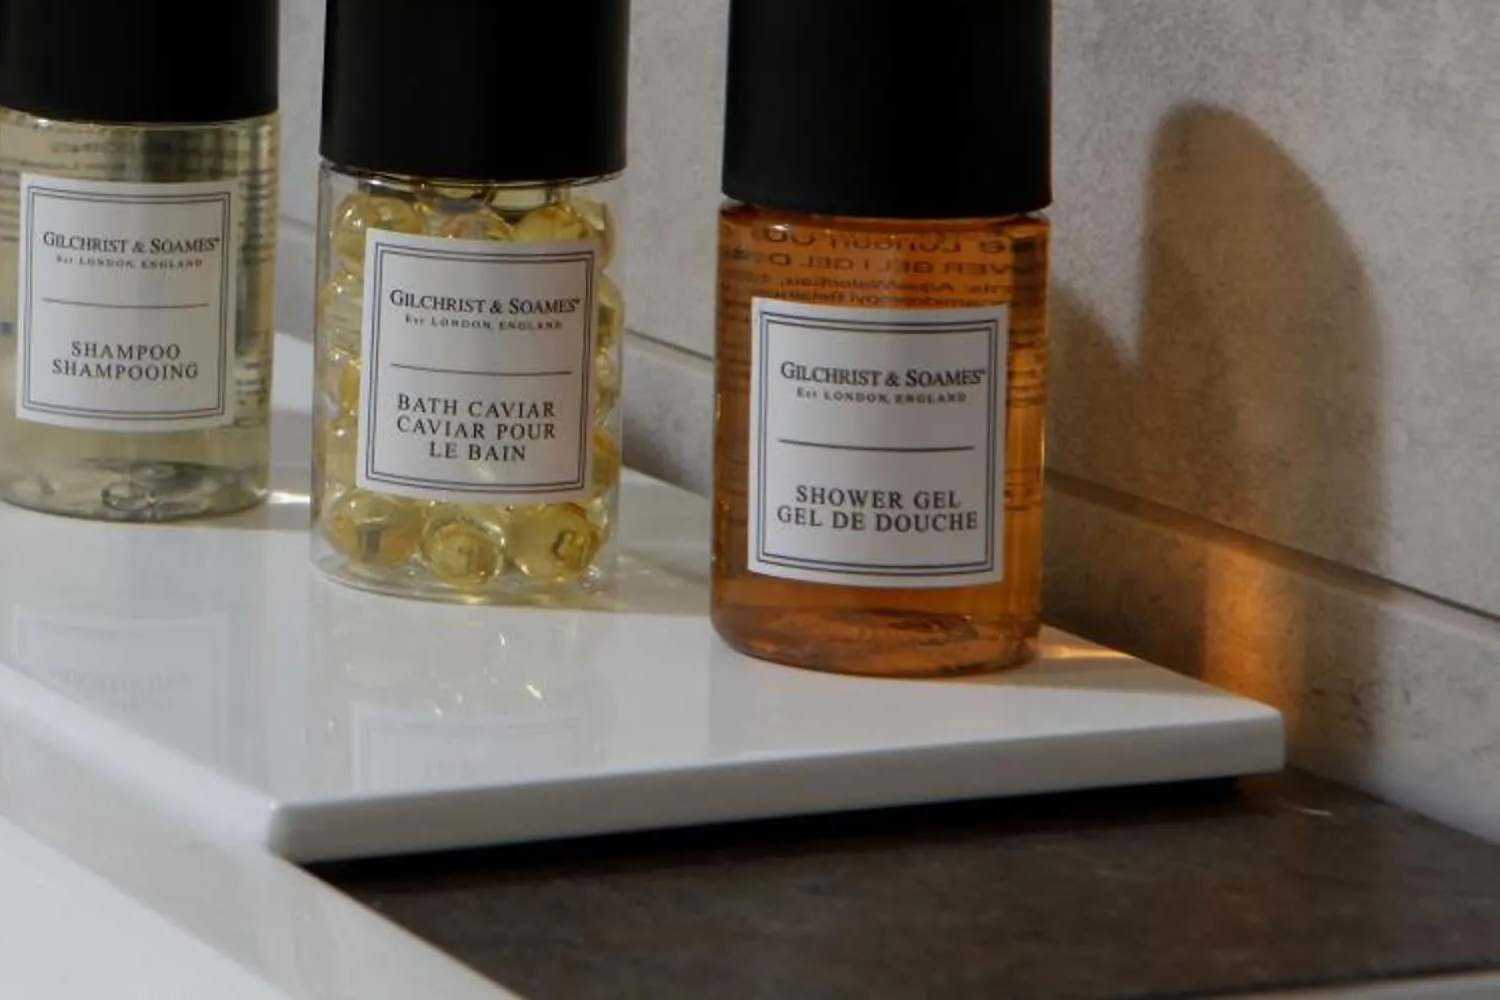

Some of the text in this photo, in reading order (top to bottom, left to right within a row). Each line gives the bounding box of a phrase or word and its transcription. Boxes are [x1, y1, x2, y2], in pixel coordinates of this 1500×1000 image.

[43, 231, 128, 253] GILCHRIST
[131, 240, 145, 253] &
[390, 289, 486, 313] GILCHRIST
[489, 299, 504, 314] &
[71, 341, 182, 361] SHAMPOO
[52, 359, 199, 381] SHAMPOOING
[780, 361, 882, 387] GILCHRIST
[884, 371, 899, 387] &
[397, 393, 556, 419] BATH CAVIAR
[397, 416, 557, 441] CAVIAR POUR
[429, 440, 526, 462] LE BAIN
[795, 484, 961, 509] SHOWER GEL
[777, 505, 978, 533] GEL DE DOUCHE
